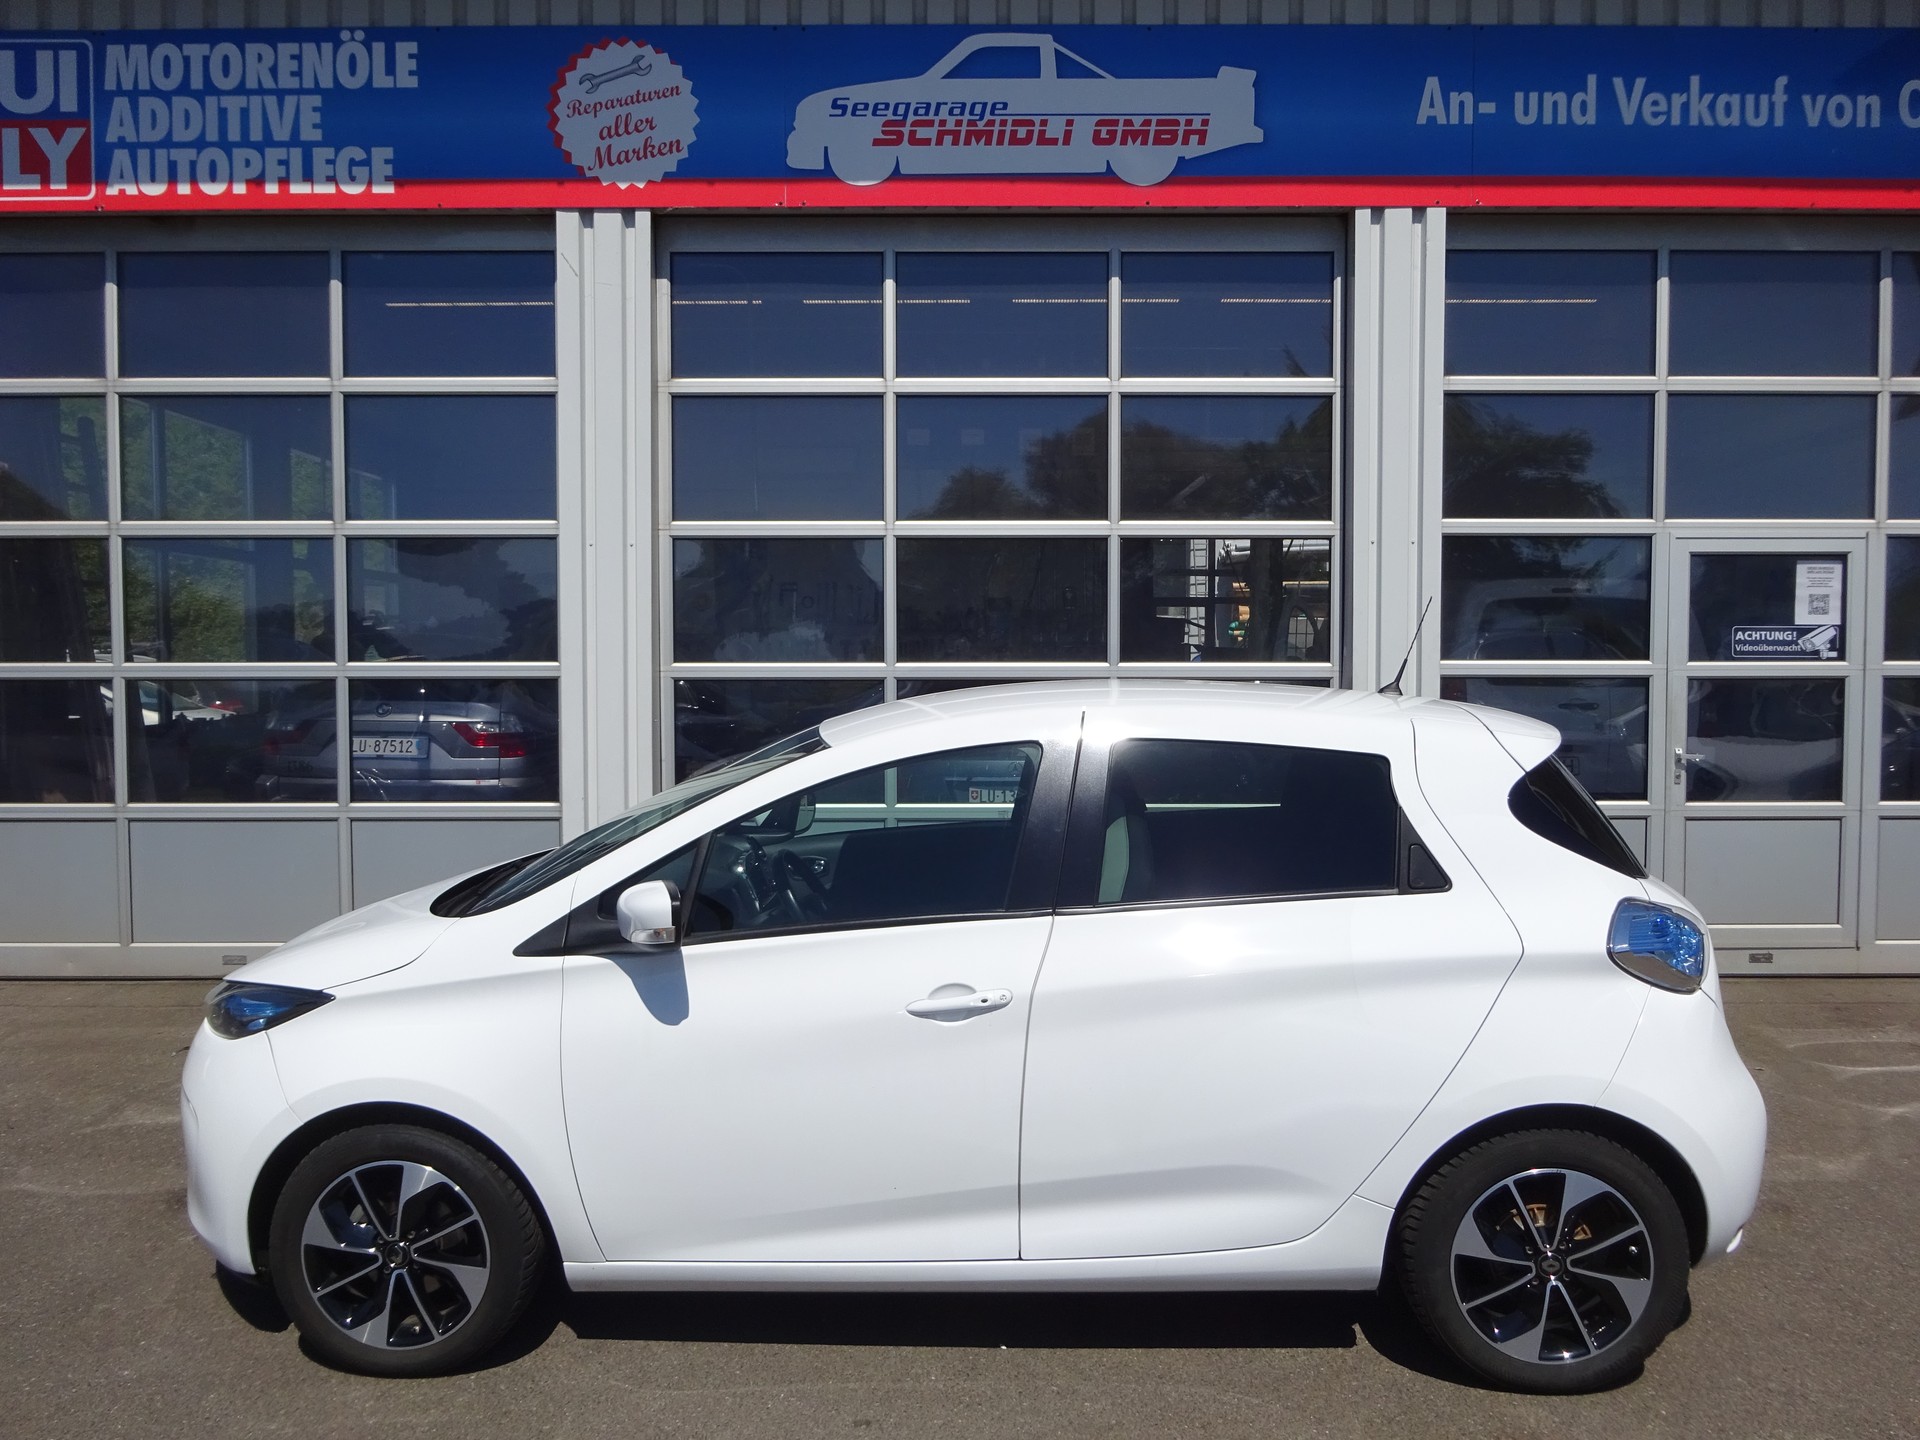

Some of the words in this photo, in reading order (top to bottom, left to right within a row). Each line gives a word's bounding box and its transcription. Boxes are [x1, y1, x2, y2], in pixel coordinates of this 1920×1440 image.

[104, 30, 418, 91] MOTORENÖLE
[566, 84, 682, 119] Reparaturen
[829, 97, 1008, 121] Seegarage
[1416, 76, 1496, 125] An-
[1514, 74, 1597, 125] und
[1612, 75, 1789, 127] Verkauf
[1801, 94, 1881, 128] von
[105, 95, 323, 143] ADDITIVE
[598, 112, 657, 141] aller
[872, 119, 1075, 147] SCHMIDLI
[1091, 119, 1211, 147] GMBH
[2, 127, 87, 190] LY
[587, 135, 684, 171] Marken
[105, 146, 395, 196] AUTOPFLEGE
[1735, 631, 1797, 641] ACHTUNG!
[1735, 643, 1802, 652] Videoüberwacht
